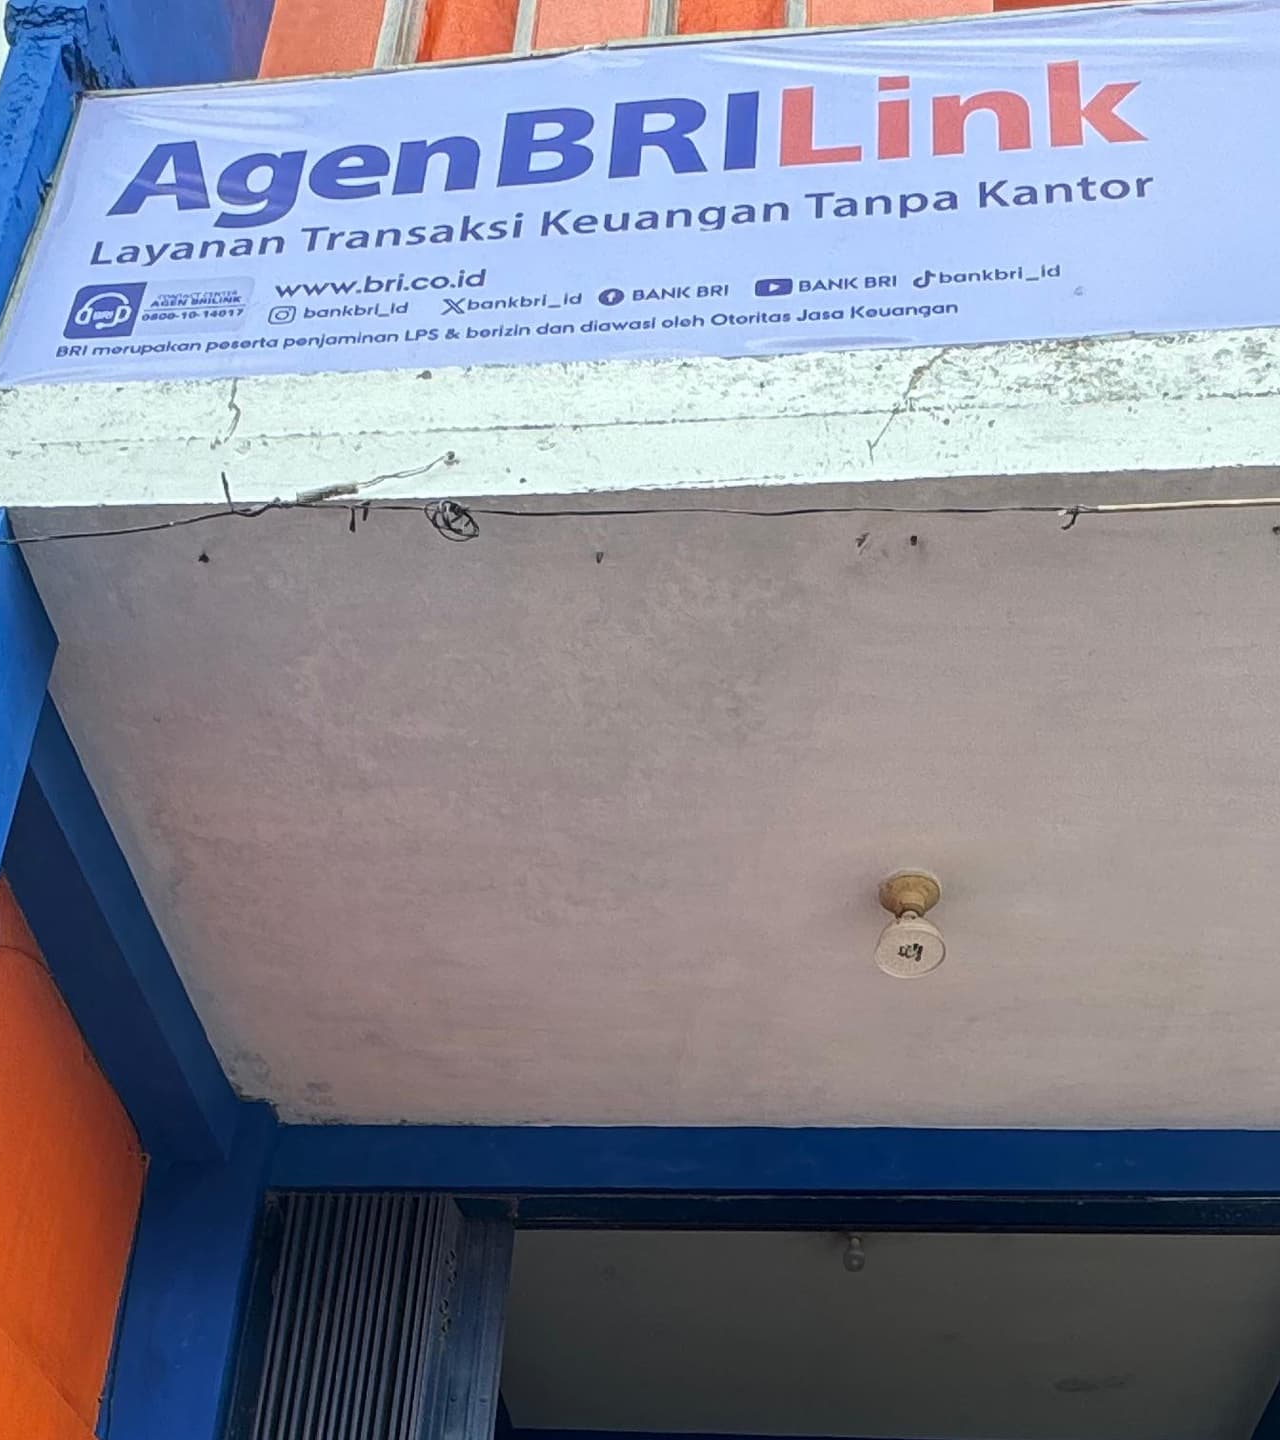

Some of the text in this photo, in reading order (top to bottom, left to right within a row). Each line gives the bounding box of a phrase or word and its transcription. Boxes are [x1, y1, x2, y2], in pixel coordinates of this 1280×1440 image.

[106, 60, 1149, 229] AgenBRILink
[90, 174, 1154, 267] Layanan Transaksi Keuangan Tanpa Kantor
[275, 269, 486, 298] www.bri.co.id
[303, 264, 1061, 320] bankbri_id bankbri_id BANK BRI BANK BRI bankbri_id
[56, 344, 88, 358] BRI
[282, 329, 400, 349] penjaminan
[404, 326, 439, 342] LPS
[445, 325, 460, 340] &
[536, 318, 575, 335] dan
[580, 315, 656, 334] diawasi
[661, 312, 705, 330] oleh
[711, 309, 791, 327] Otoritas
[797, 306, 844, 322] Jasa
[850, 301, 959, 320] Keuangan
